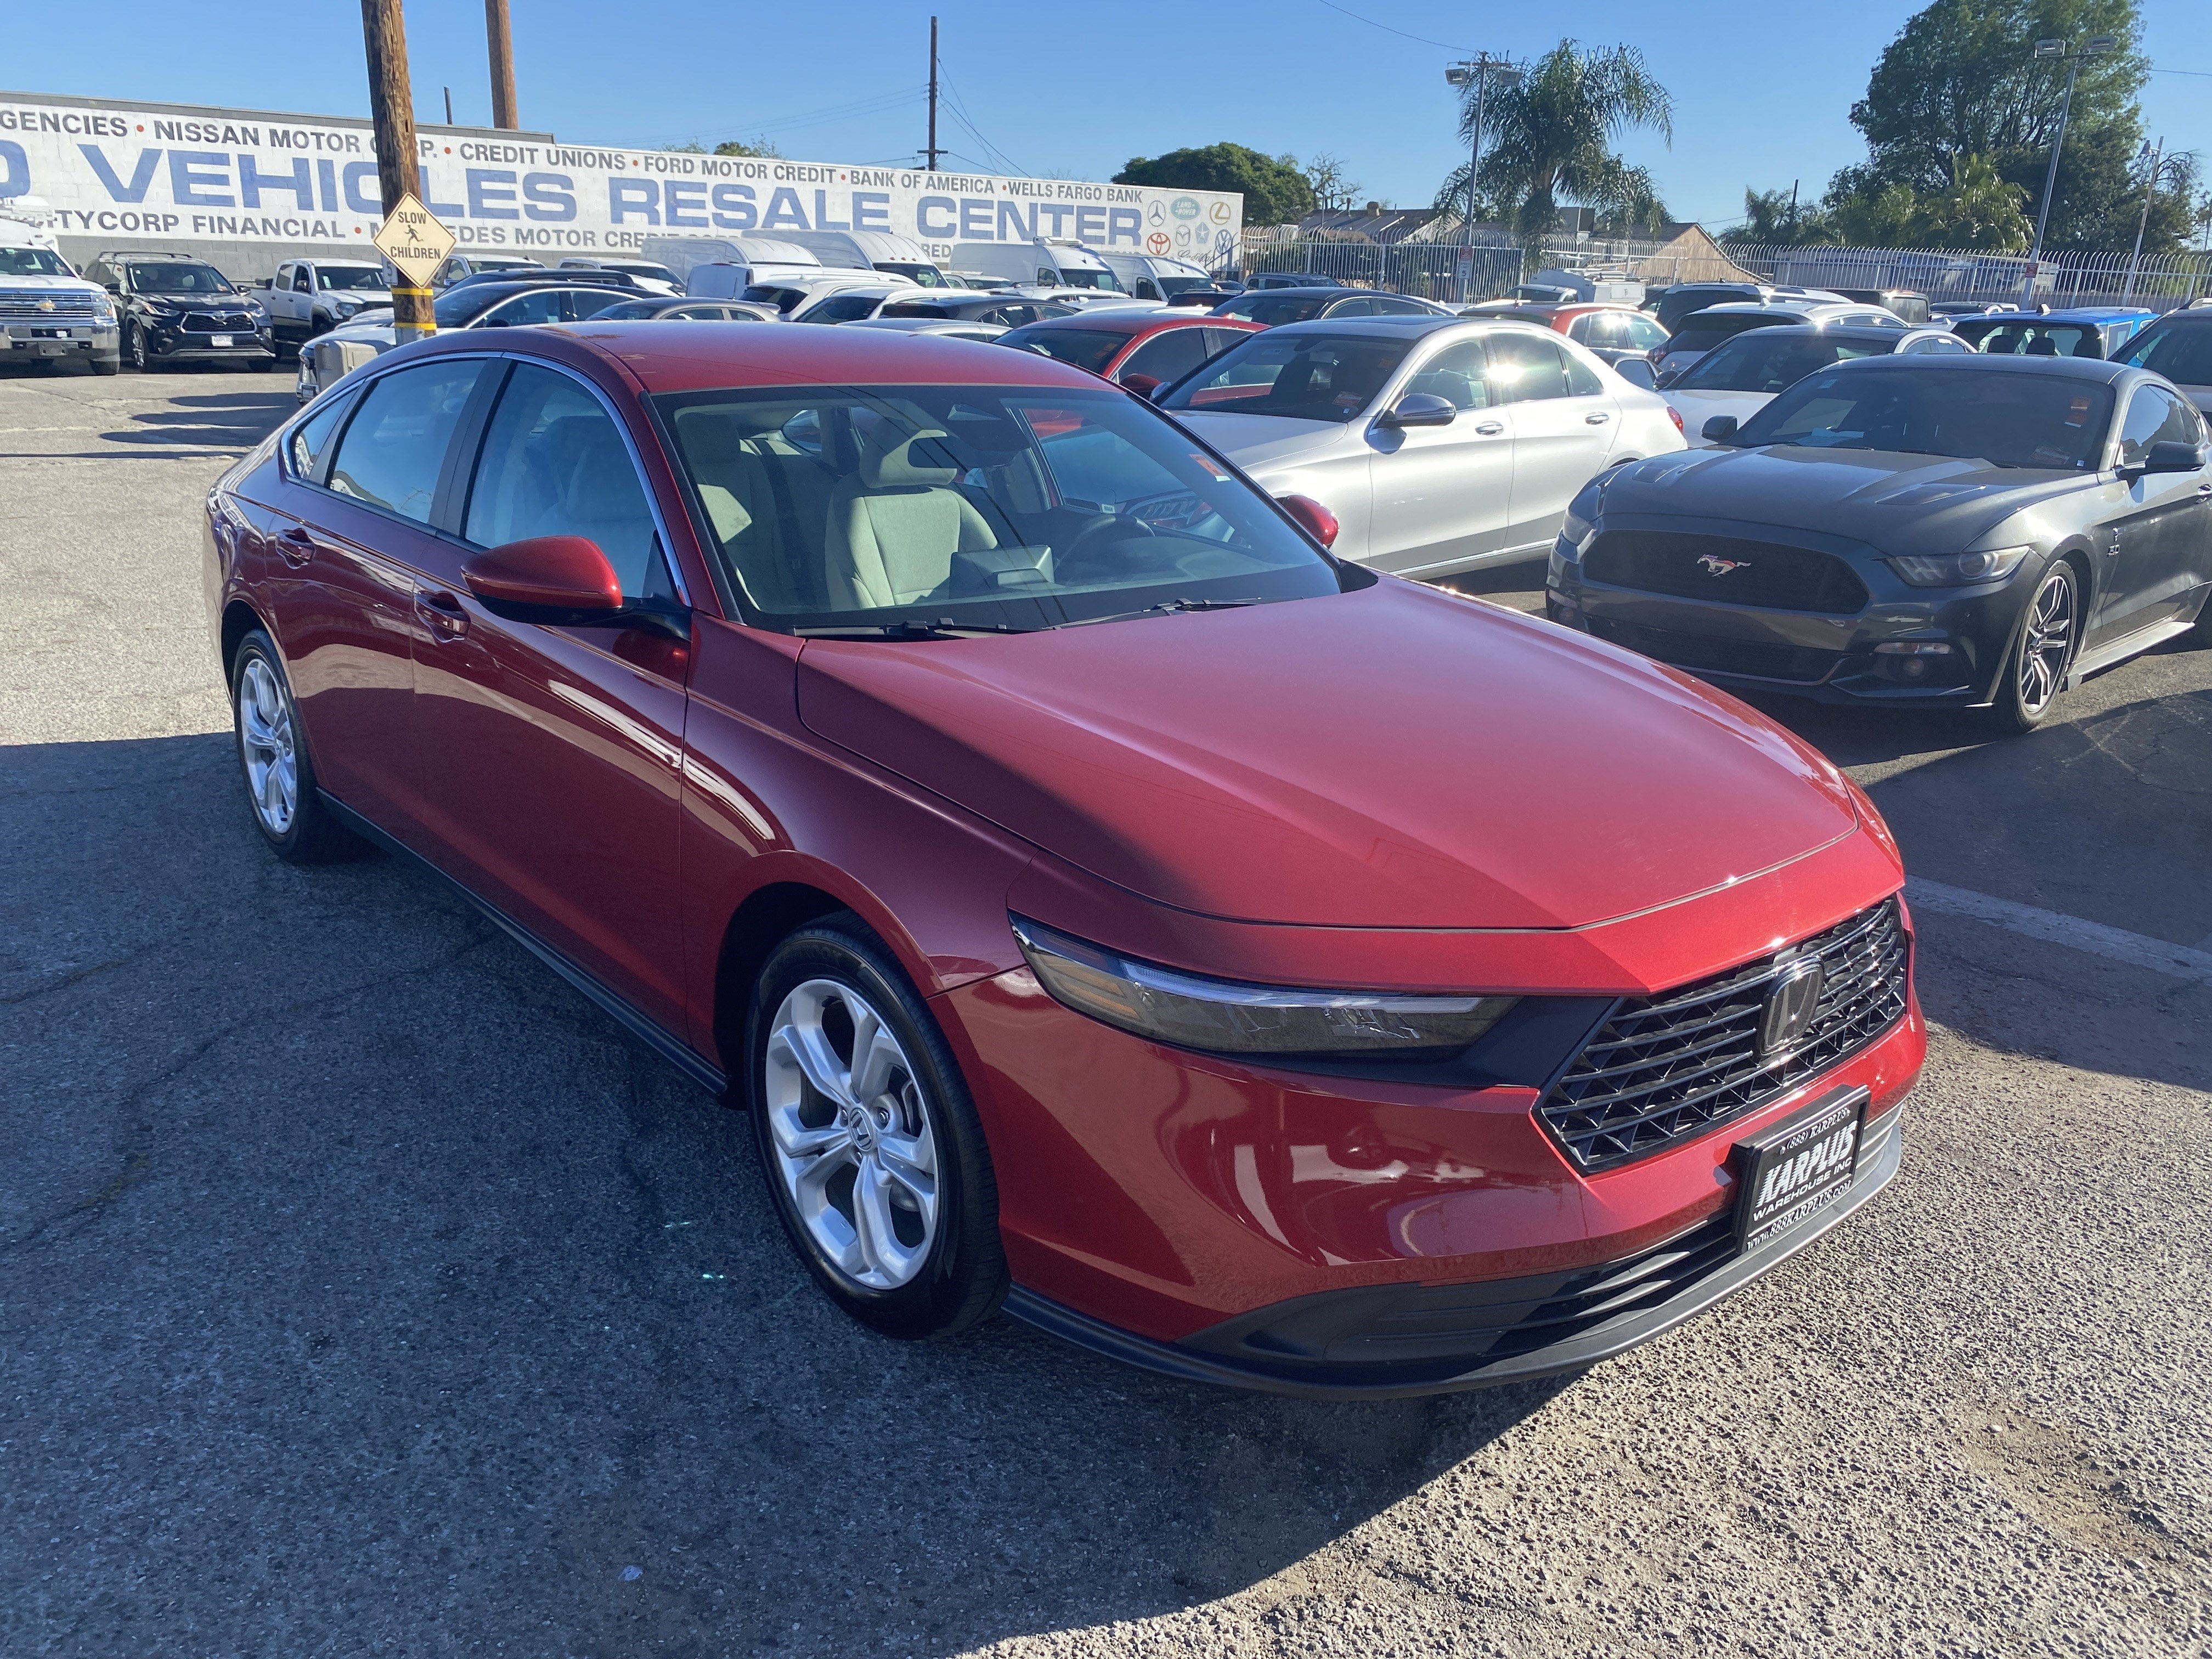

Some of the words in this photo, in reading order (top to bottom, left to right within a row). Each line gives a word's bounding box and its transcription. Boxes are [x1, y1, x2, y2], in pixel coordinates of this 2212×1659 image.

[154, 120, 261, 146] NISSAN
[269, 128, 361, 153] MOTOR
[460, 143, 538, 164] CREDIT
[546, 148, 626, 170] UNIONS
[644, 156, 694, 174] FORD
[701, 160, 768, 179] MOTOR
[774, 165, 837, 183] CREDIT
[850, 170, 895, 187] BANK
[901, 173, 921, 188] OF
[925, 176, 995, 194] AMERICA
[1008, 181, 1053, 198] WELLS
[1058, 185, 1102, 201] FARGO
[1107, 188, 1143, 203] BANK
[76, 144, 577, 222] VEHICLES
[608, 177, 890, 233] RESALE
[917, 196, 1142, 246] CENTER
[192, 215, 346, 238] FINANCIAL
[515, 228, 596, 247] MOTOR
[398, 211, 427, 224] SLOW
[386, 261, 393, 276] 5
[390, 246, 441, 259] CHILDREN
[1787, 1130, 1808, 1150] (888)
[1809, 1108, 1848, 1139] KARPLUS
[1755, 1120, 1858, 1208] KARPLUS
[1753, 1170, 1832, 1222] WAREHOUSE
[1833, 1156, 1853, 1175] INC
